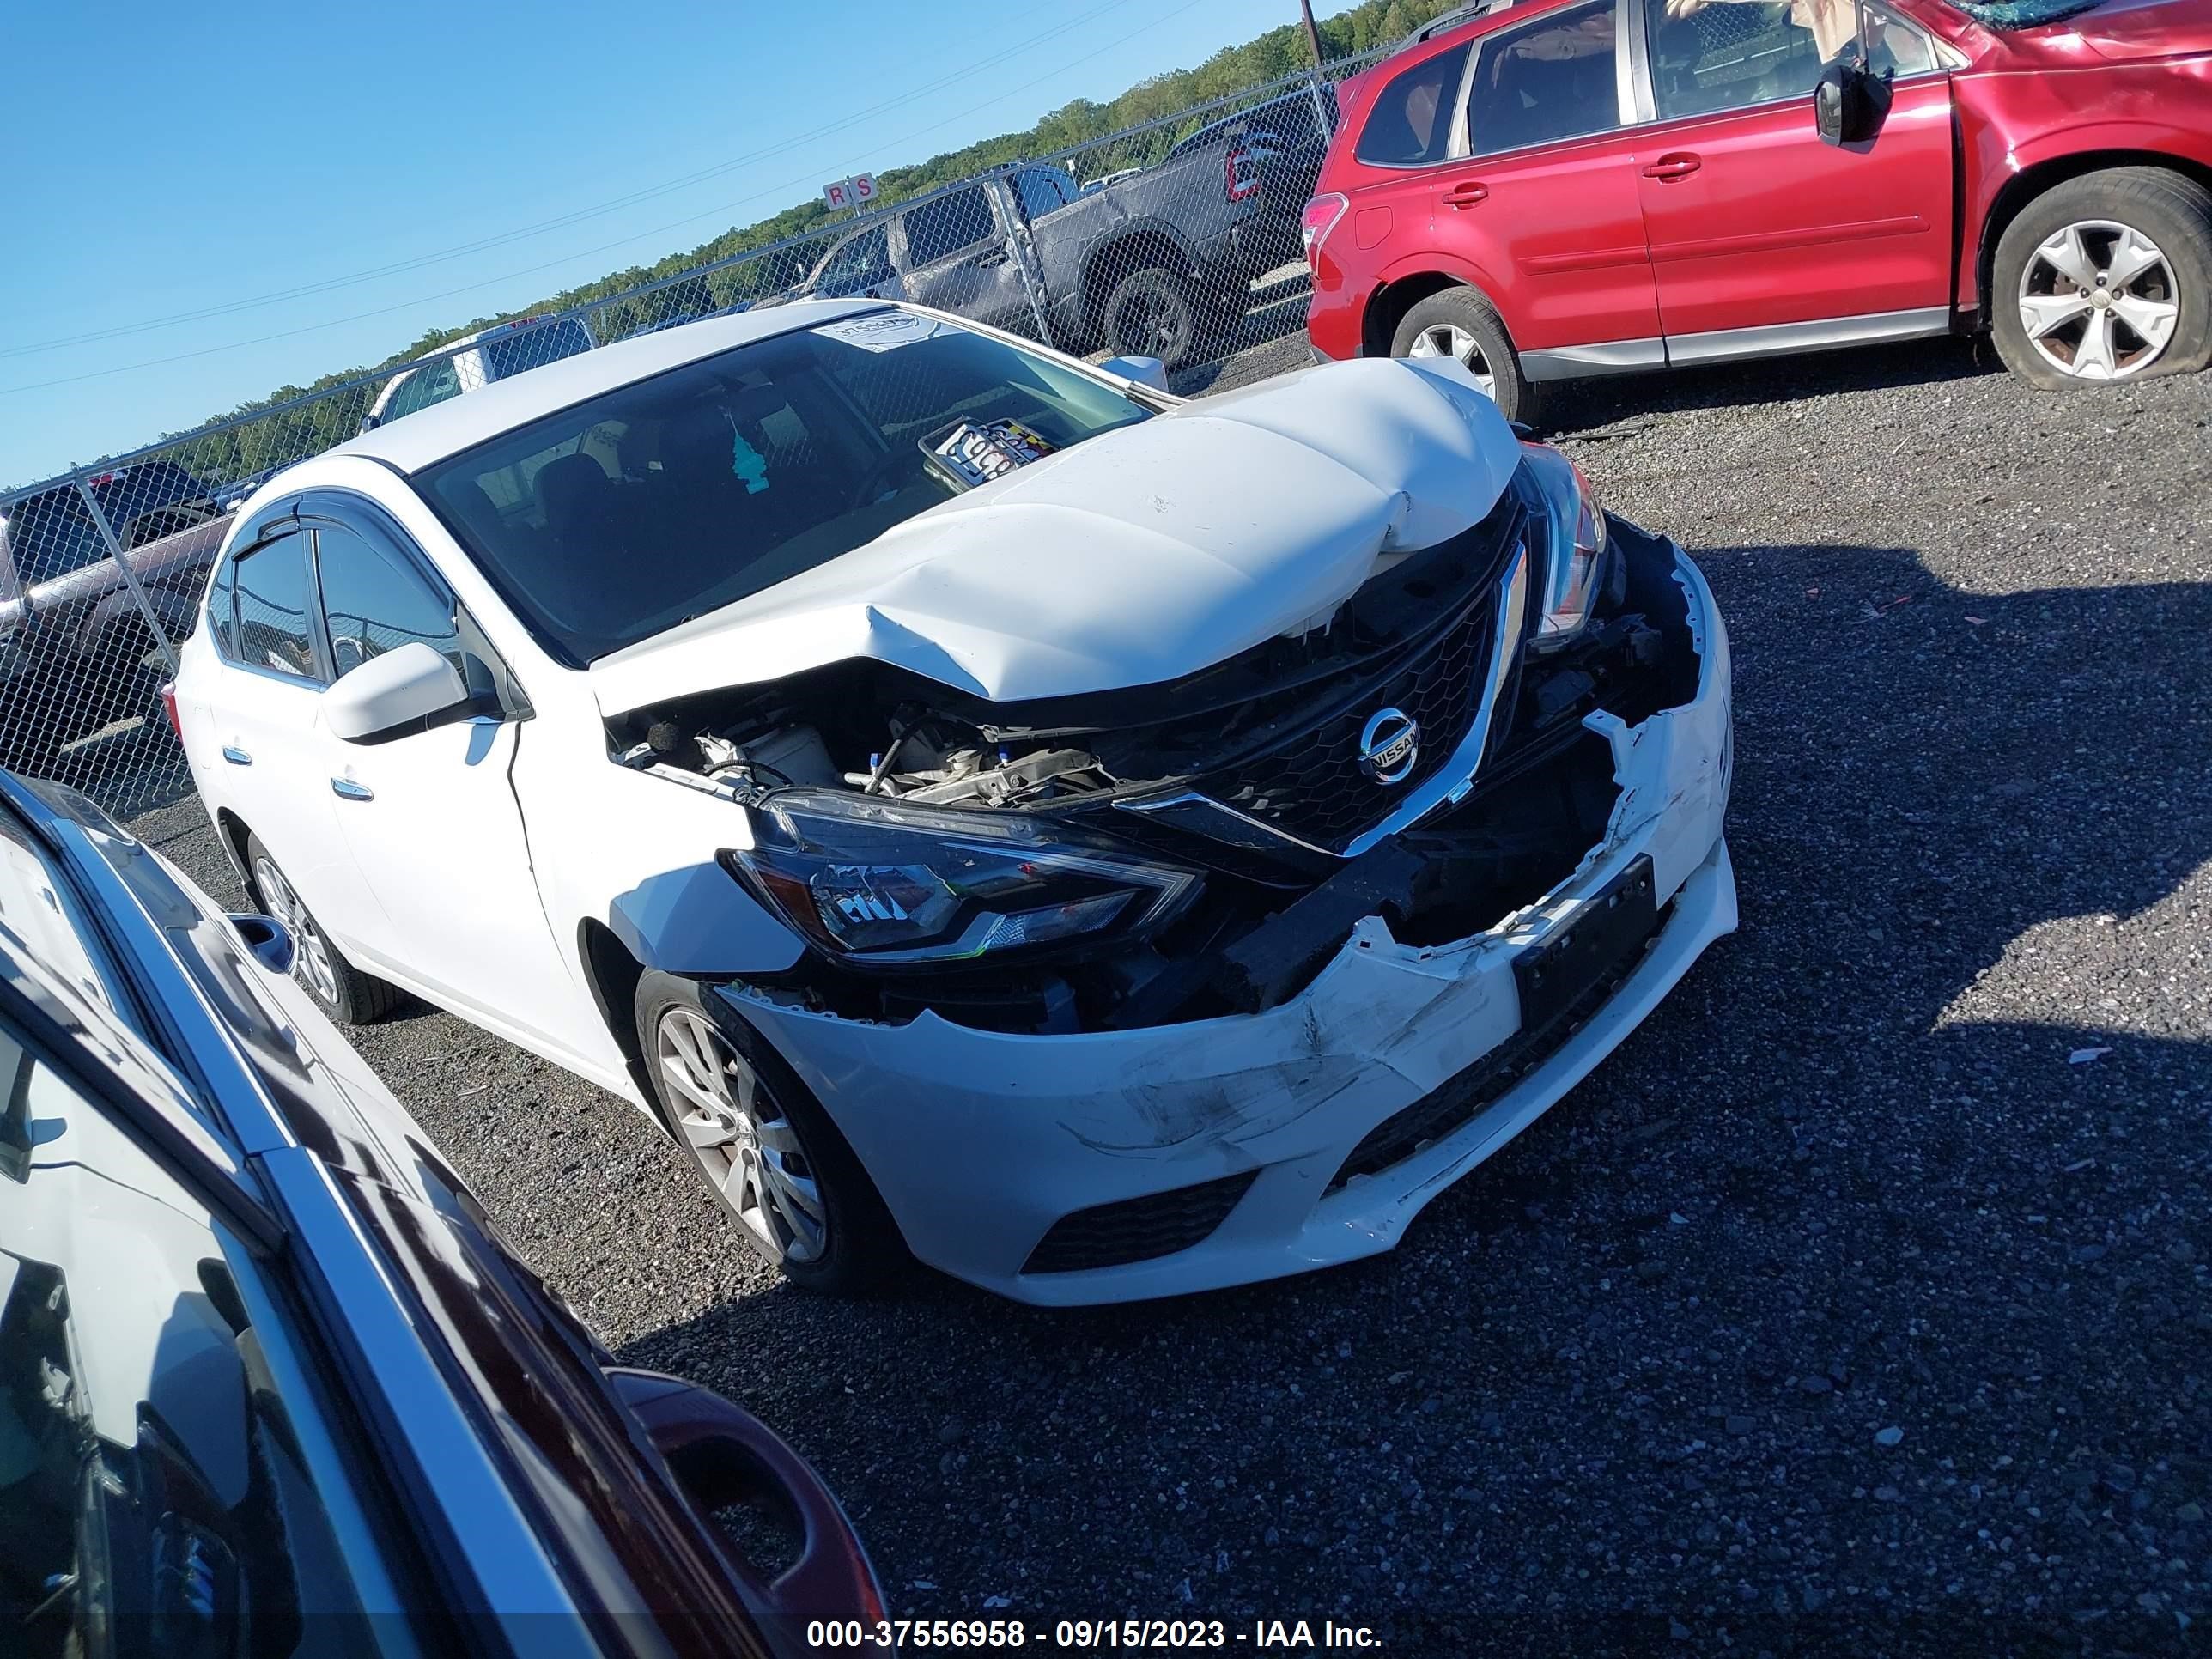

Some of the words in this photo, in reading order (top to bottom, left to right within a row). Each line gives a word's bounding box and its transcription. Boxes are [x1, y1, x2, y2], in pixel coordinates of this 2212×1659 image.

[829, 186, 845, 205] R
[857, 179, 872, 197] S
[836, 317, 915, 337] 375569
[1370, 727, 1417, 765] NISSAN
